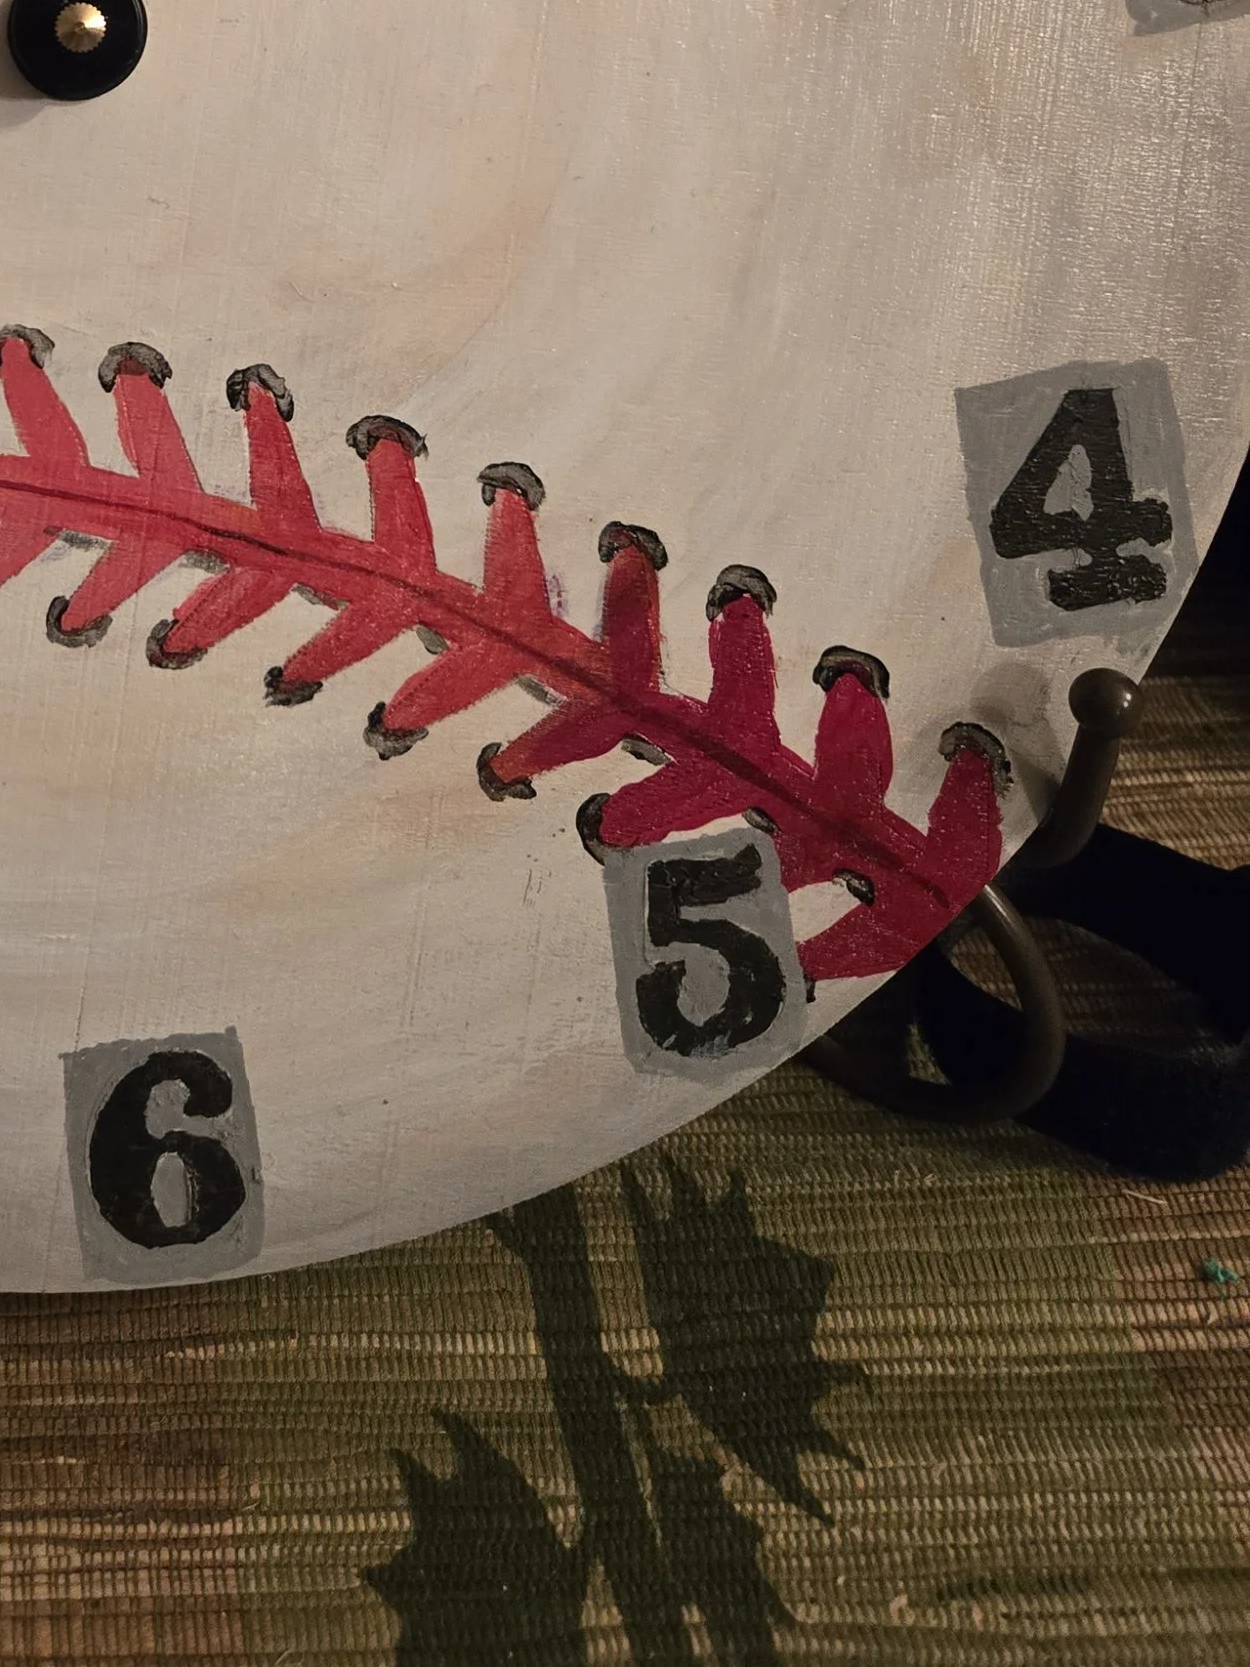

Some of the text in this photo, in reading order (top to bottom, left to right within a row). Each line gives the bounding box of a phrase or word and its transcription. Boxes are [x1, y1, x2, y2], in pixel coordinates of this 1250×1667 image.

[988, 388, 1173, 610] 4
[637, 844, 786, 1056] 5
[89, 1052, 246, 1248] 6
